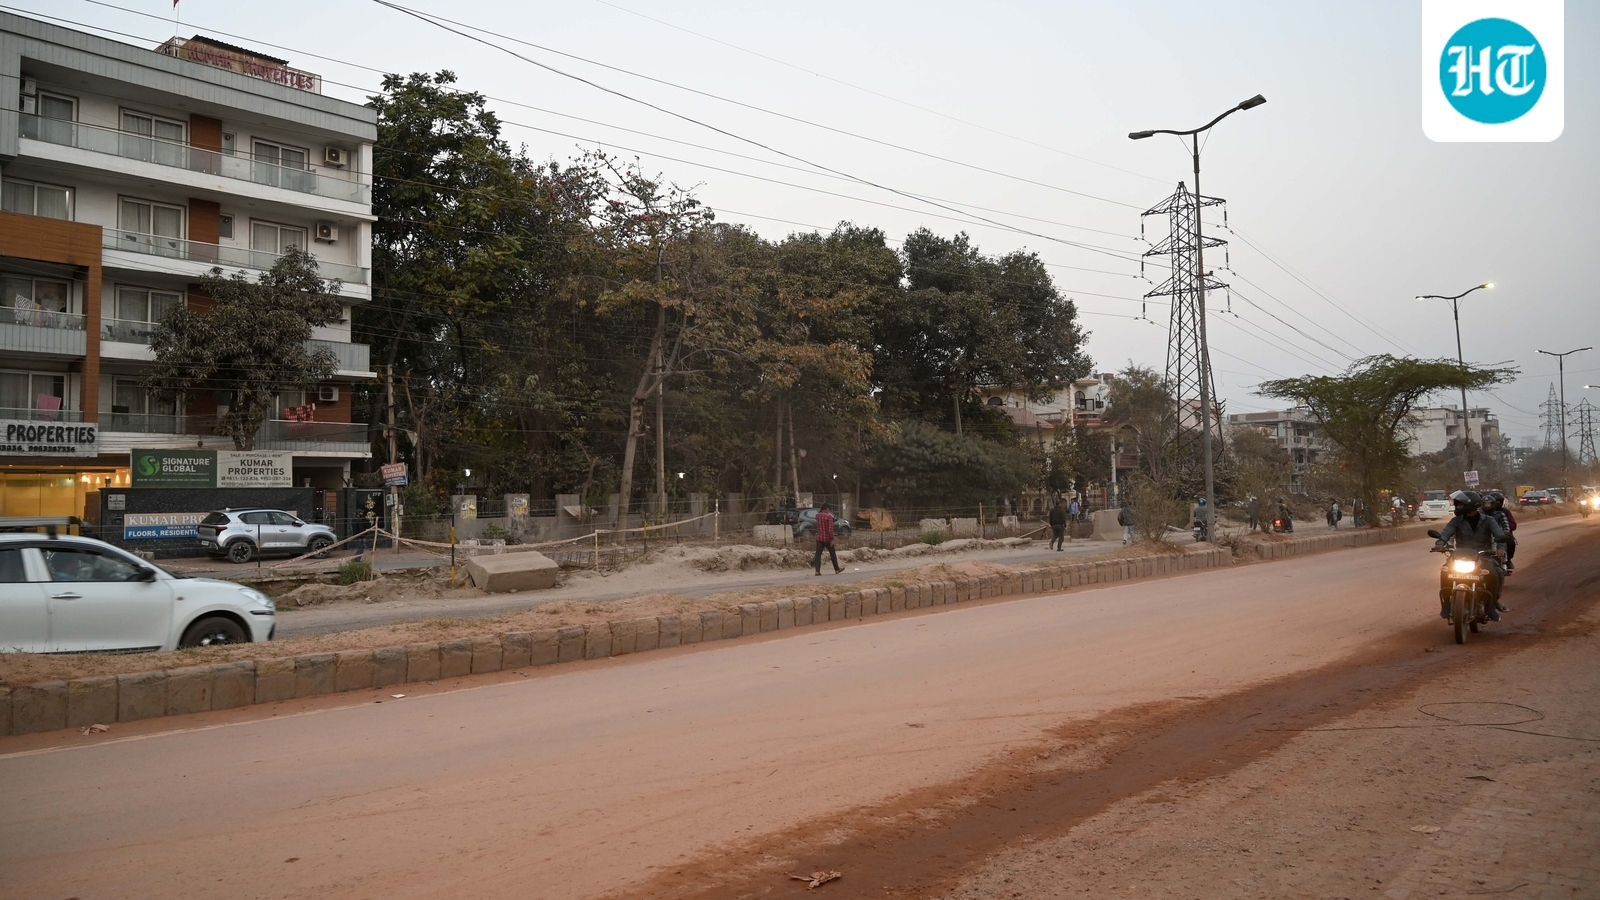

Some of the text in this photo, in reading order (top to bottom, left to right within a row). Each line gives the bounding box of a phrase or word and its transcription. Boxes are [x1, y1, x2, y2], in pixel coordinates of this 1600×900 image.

[187, 45, 314, 90] KUMAR PROPERTIES
[7, 424, 95, 443] PROPERTIES
[162, 457, 210, 465] SIGNATURE
[240, 459, 273, 467] KUMAR
[228, 467, 285, 475] PROPERTIES
[128, 515, 178, 525] KUMAR
